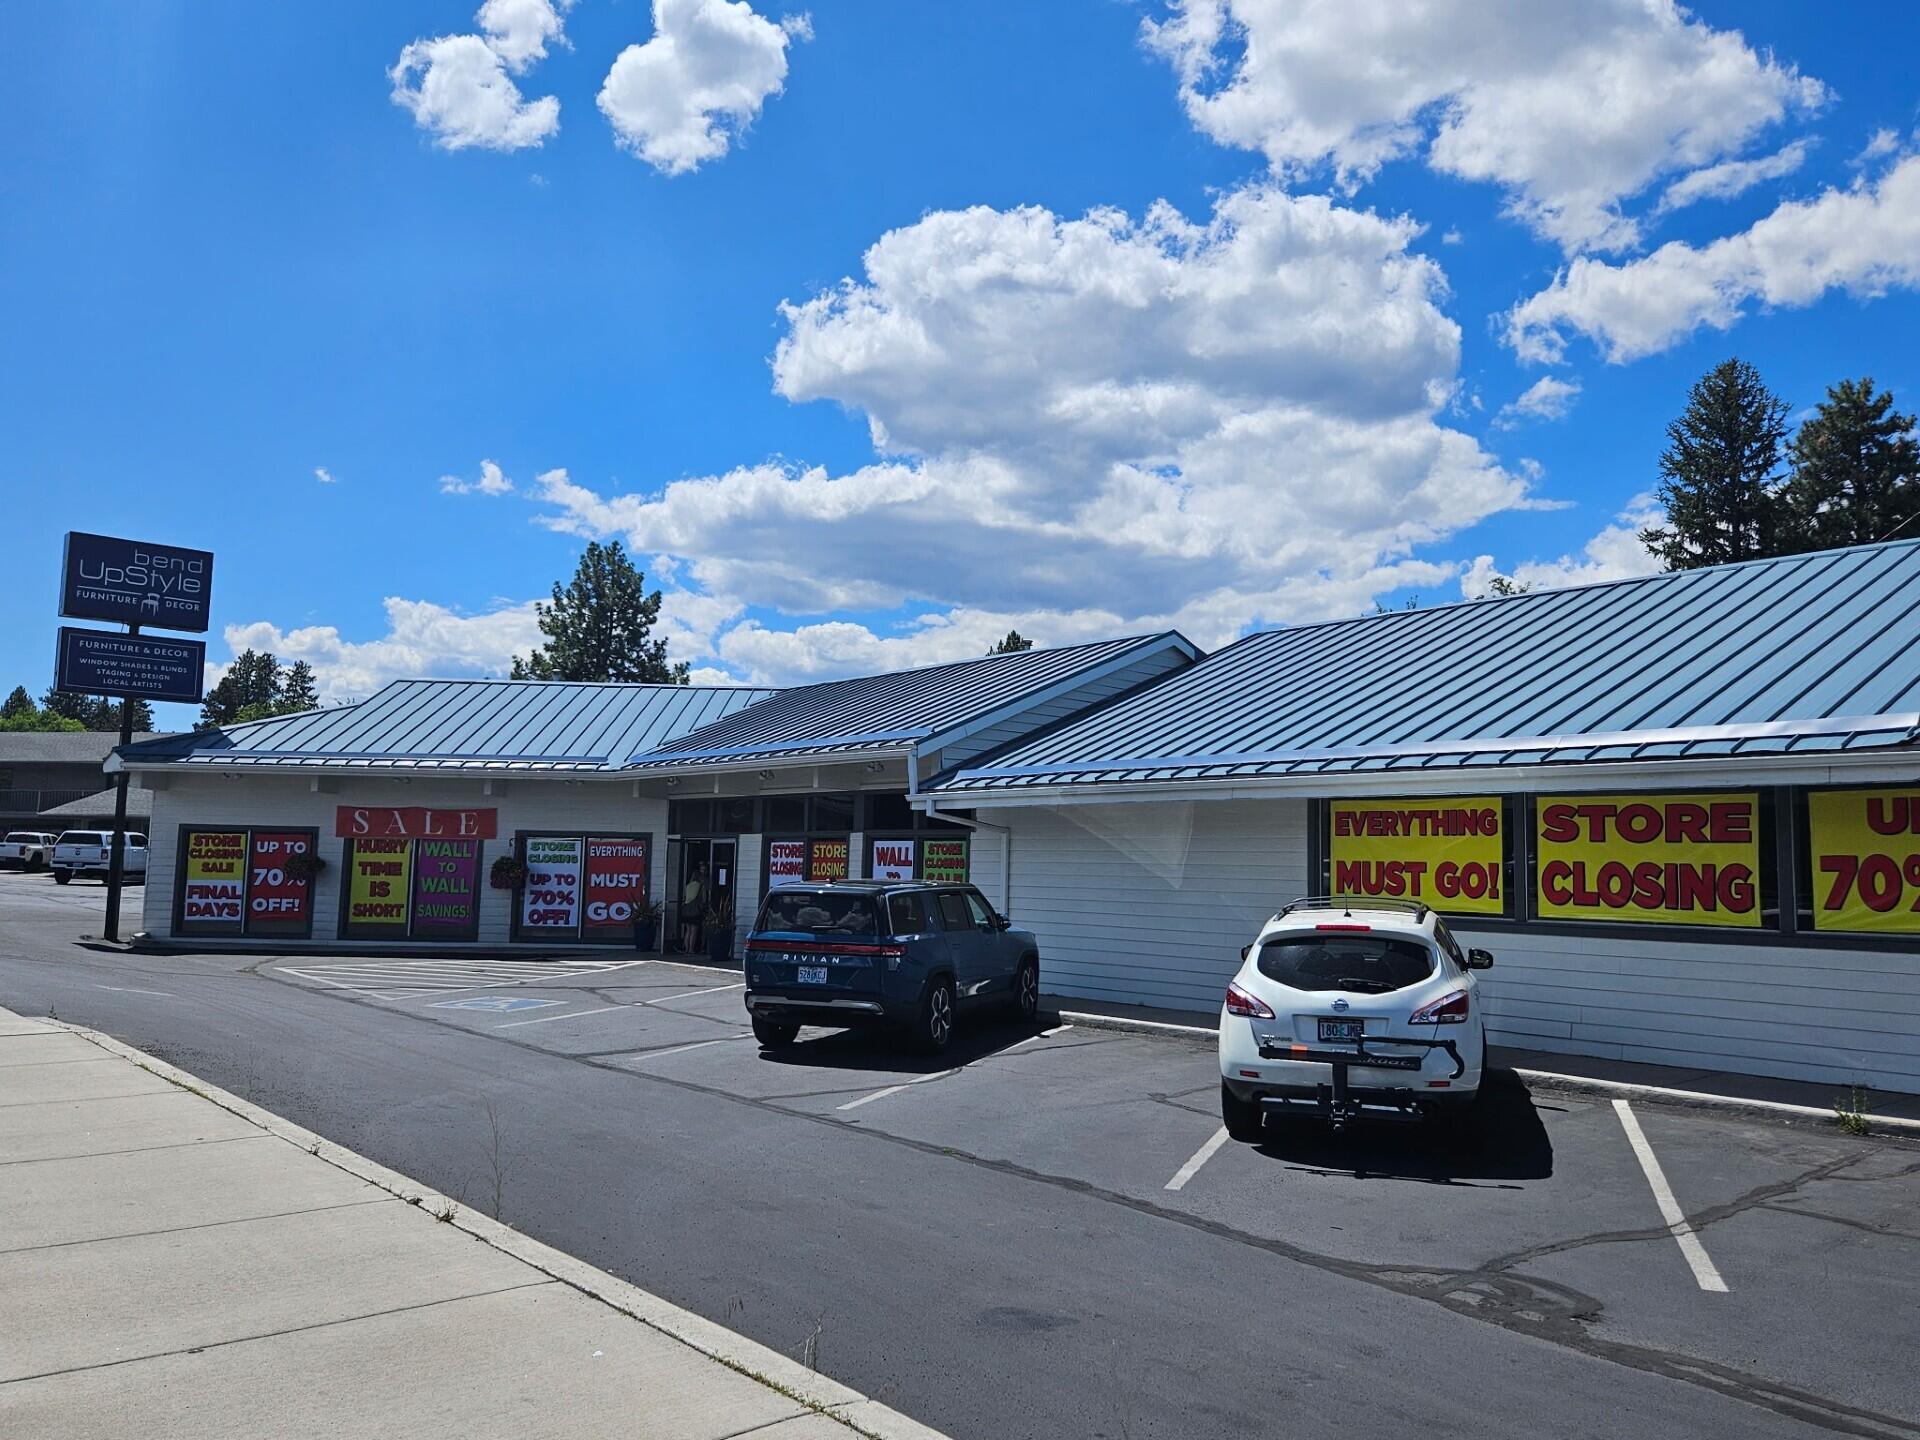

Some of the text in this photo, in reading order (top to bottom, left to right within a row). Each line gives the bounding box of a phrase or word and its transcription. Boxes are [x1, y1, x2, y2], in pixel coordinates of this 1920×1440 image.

[134, 549, 203, 574] bend
[80, 559, 201, 593] UpStyle
[76, 589, 200, 611] FURNITURE DECOR
[79, 640, 189, 658] FURNITURE & DECOR
[79, 658, 118, 667] WINDOW
[120, 662, 151, 670] SHADES
[160, 665, 188, 674] BLINDS
[96, 668, 131, 677] STAGING
[141, 673, 170, 681] DESIGN
[103, 678, 163, 689] LOCAL ARTISTS
[352, 809, 479, 835] SALE
[1334, 808, 1498, 837] EVERYTHING
[1540, 802, 1753, 844] STORE
[193, 834, 242, 848] STORE
[256, 841, 307, 854] UP TO
[355, 839, 408, 854] HURRY
[530, 841, 576, 852] STORE
[190, 848, 244, 860] CLOSING
[424, 841, 472, 858] WALL
[589, 846, 643, 857] EVERYTHING
[771, 844, 804, 859] STORE
[813, 844, 847, 858] STORE
[875, 846, 912, 867] WALL
[927, 843, 963, 856] STORE
[527, 853, 579, 864] CLOSING
[925, 857, 965, 869] CLOSING
[201, 861, 235, 873] SALE
[358, 861, 403, 876] TIME
[438, 862, 457, 873] TO
[812, 862, 845, 876] CLOSING
[420, 876, 470, 894] WALL
[529, 873, 576, 886] UP TO
[590, 873, 640, 888] MUST
[1335, 860, 1500, 900] MUST GO!
[1541, 860, 1756, 914] CLOSING
[187, 885, 243, 900] FINAL
[369, 881, 391, 898] IS
[252, 898, 300, 912] OFF!
[528, 889, 575, 906] 70%
[186, 902, 240, 918] DAYS
[352, 903, 405, 918] SHORT
[417, 904, 471, 919] SAVINGS!
[527, 908, 571, 926] OFF!
[782, 953, 840, 964] RIVIAN
[1320, 1023, 1338, 1037] 180
